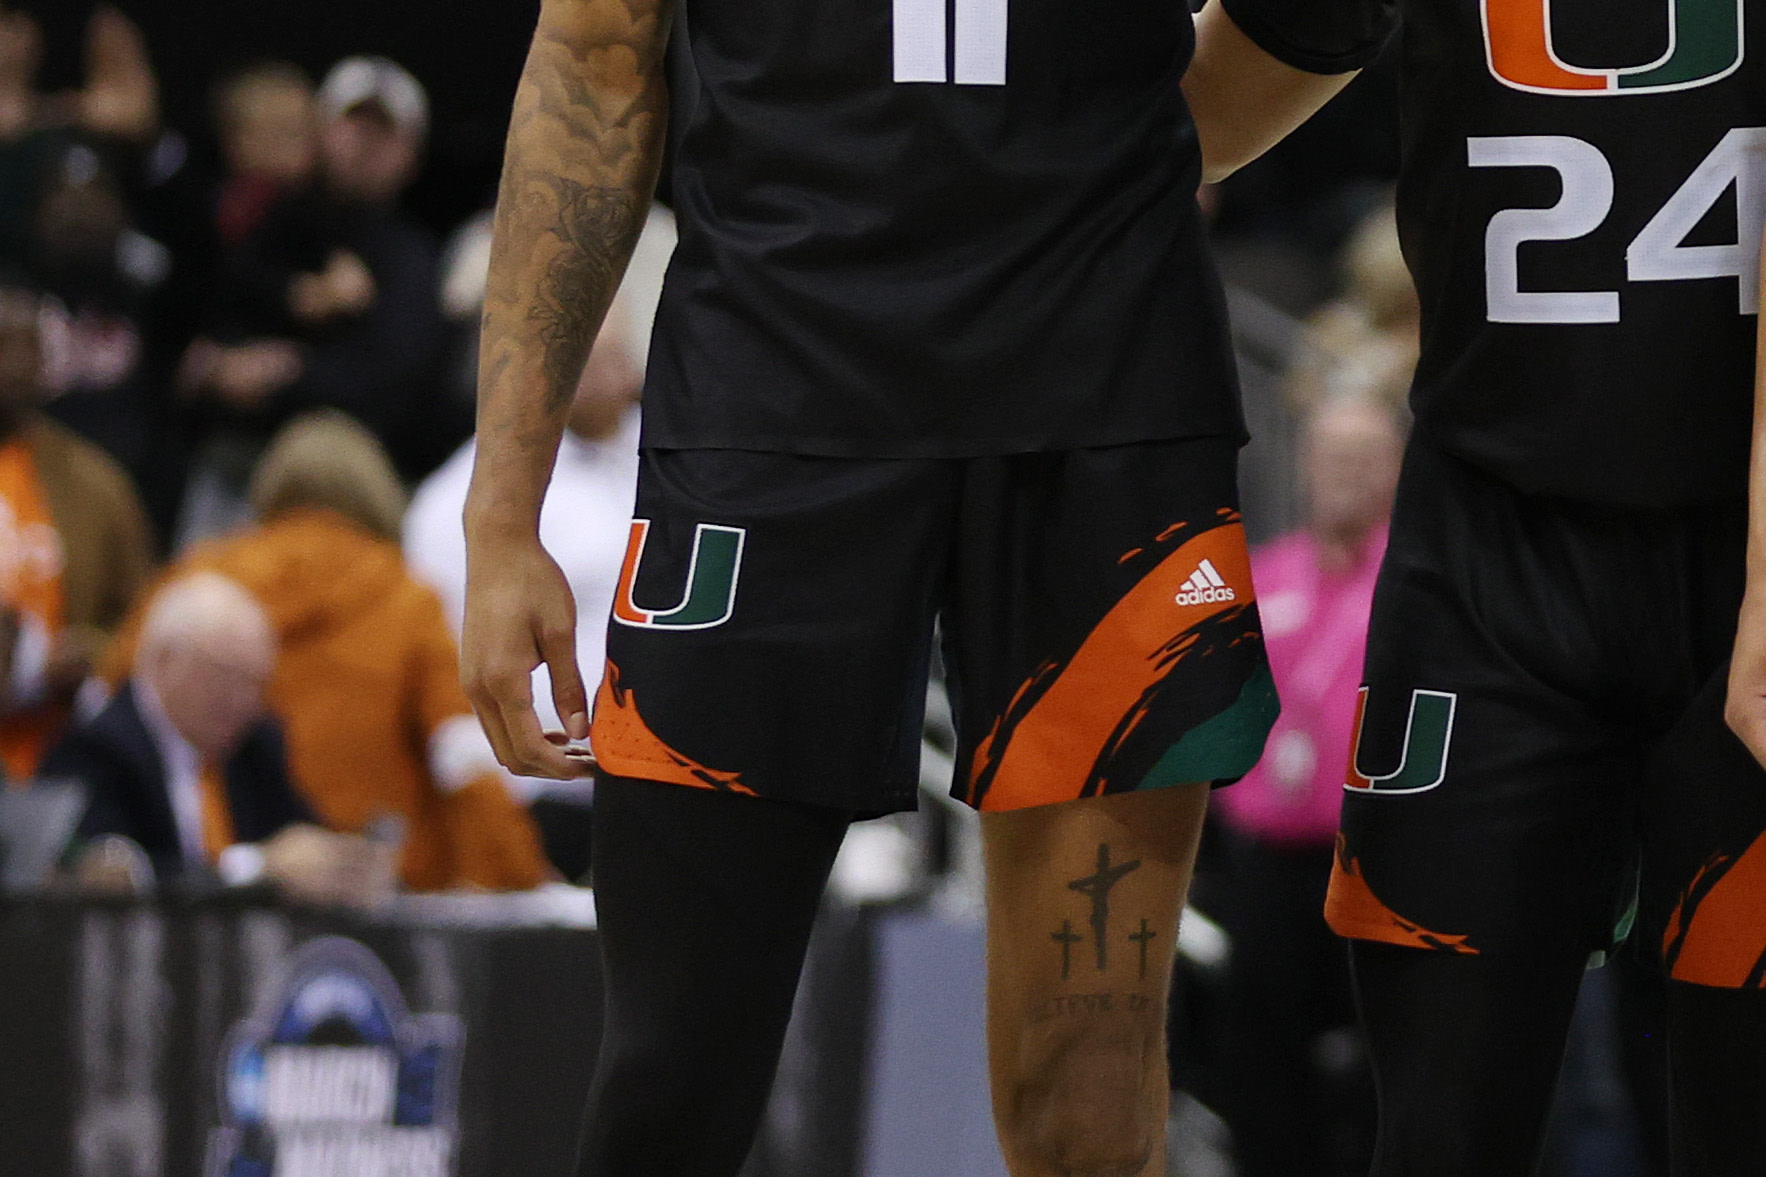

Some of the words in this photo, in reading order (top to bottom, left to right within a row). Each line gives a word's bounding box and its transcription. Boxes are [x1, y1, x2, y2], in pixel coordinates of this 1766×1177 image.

[613, 518, 746, 630] U
[1175, 586, 1236, 606] adidas
[1342, 686, 1457, 794] U
